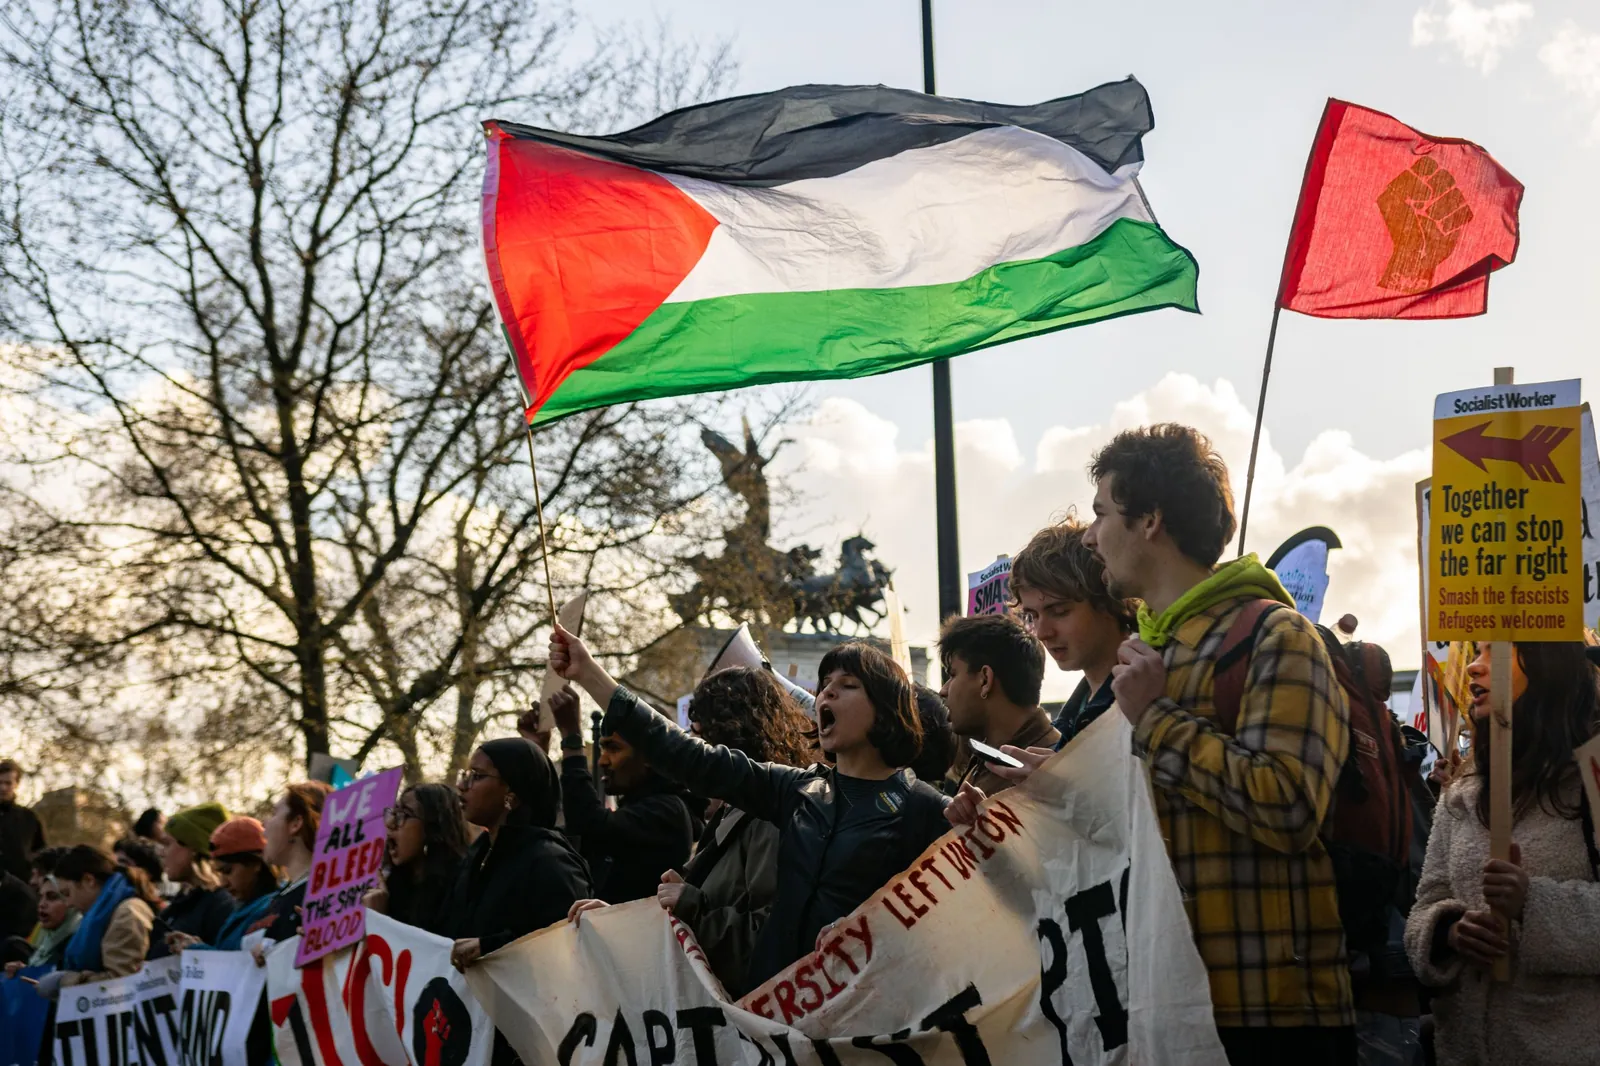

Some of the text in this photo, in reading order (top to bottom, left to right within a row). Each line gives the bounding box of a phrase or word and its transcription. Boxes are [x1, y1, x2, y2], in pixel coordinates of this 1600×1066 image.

[1442, 481, 1529, 518] Together
[1441, 523, 1464, 545] we
[1471, 520, 1506, 543] can
[1516, 514, 1563, 548] stop
[1440, 548, 1469, 577] the
[1476, 546, 1507, 576] far
[1516, 545, 1568, 582] right
[1439, 585, 1570, 606] Smash the fascists
[1438, 609, 1566, 633] Refugees welcome
[328, 781, 378, 825] WE
[323, 818, 366, 854] ALL
[310, 836, 385, 895] BLEED
[881, 855, 956, 931] LEFT
[940, 799, 1026, 881] UNION
[305, 877, 375, 924] THE SAME
[302, 910, 363, 956] BLOOD
